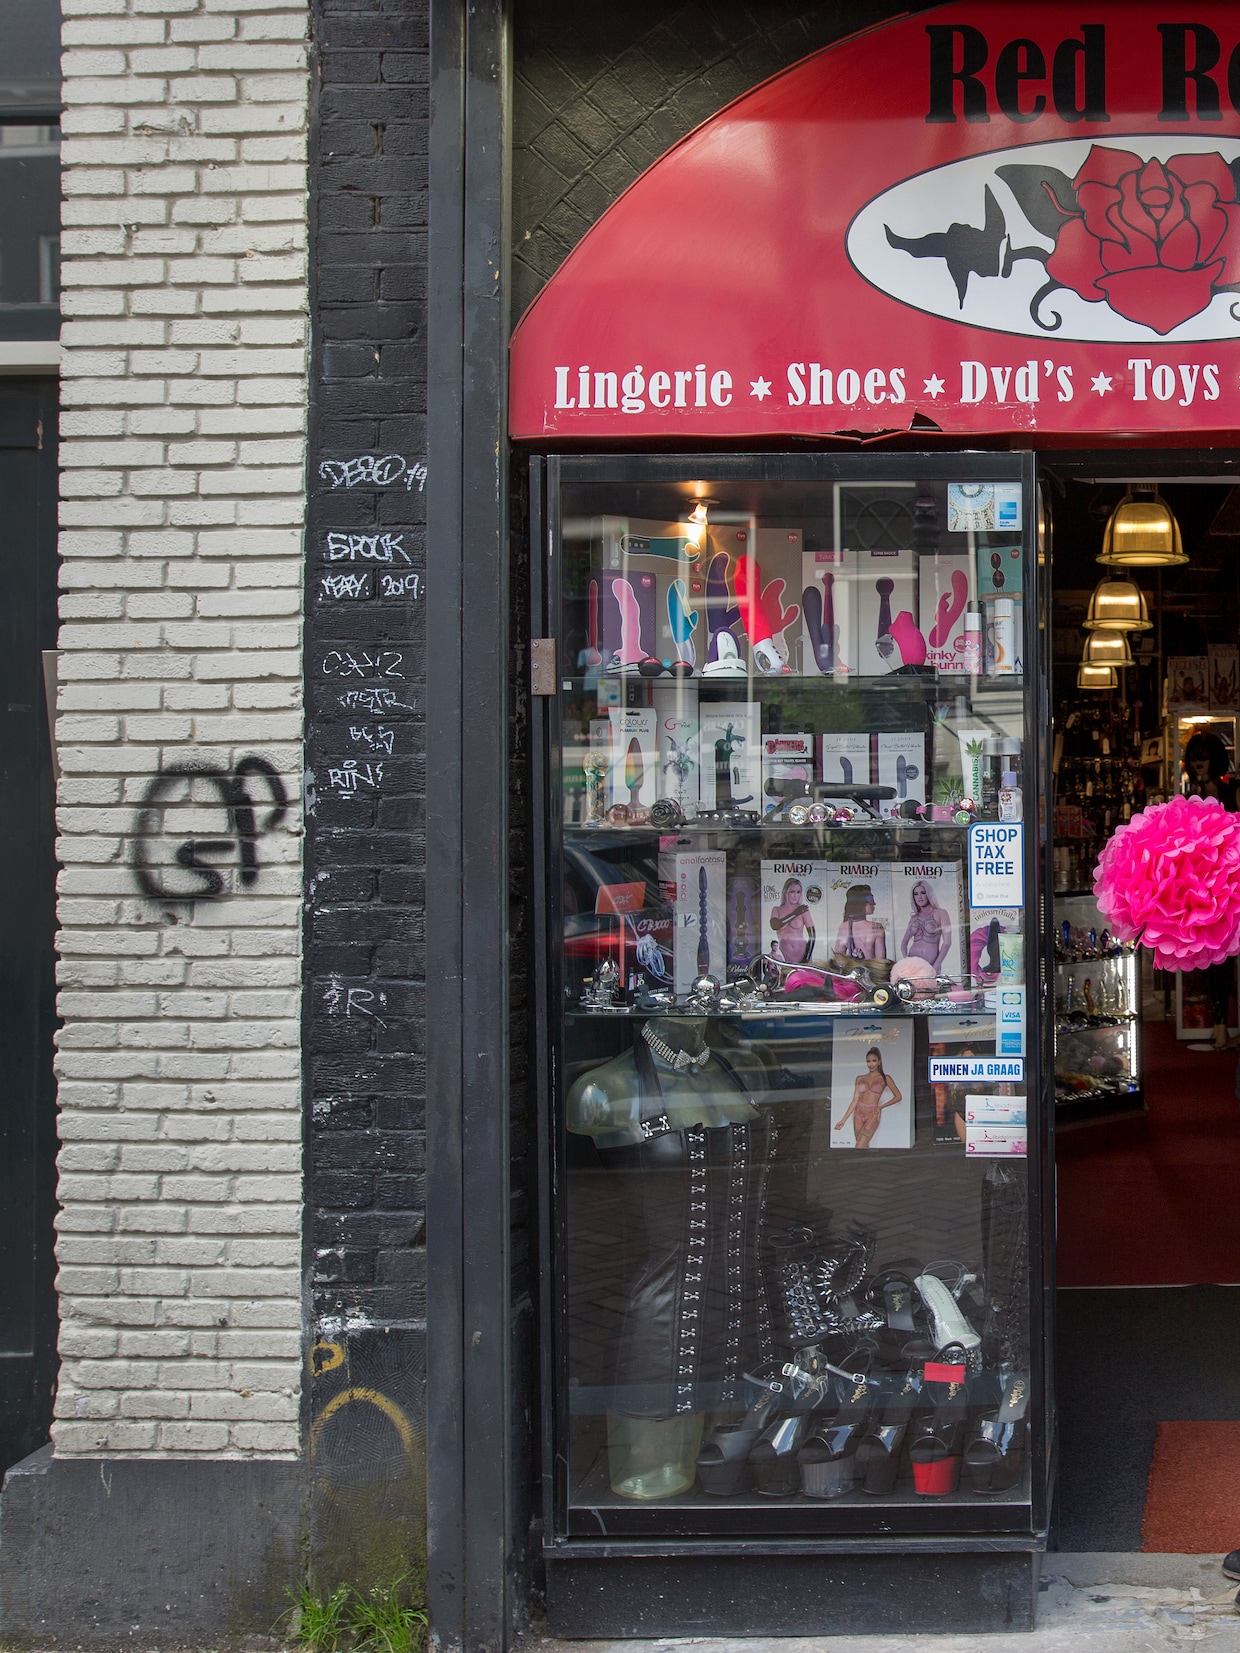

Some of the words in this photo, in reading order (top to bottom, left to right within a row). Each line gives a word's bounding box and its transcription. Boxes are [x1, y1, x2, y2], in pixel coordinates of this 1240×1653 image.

[925, 23, 1110, 124] Red
[554, 364, 733, 414] Lingerie
[786, 362, 907, 406] Shoes
[959, 360, 1074, 404] Dvd's
[1127, 358, 1220, 406] Toys
[925, 650, 957, 661] kinky
[972, 757, 980, 802] CANNABIS
[975, 829, 1017, 843] SHOP
[975, 845, 1005, 859] TAX
[774, 863, 813, 876] RIMBA
[840, 864, 879, 877] RIMBA
[904, 865, 943, 878] RIMBA
[975, 861, 1014, 875] FREE
[933, 1064, 969, 1076] PINNEN
[971, 1064, 984, 1075] JA
[987, 1063, 1021, 1075] GRAAG
[967, 1111, 975, 1121] 5
[968, 1142, 976, 1152] 5
